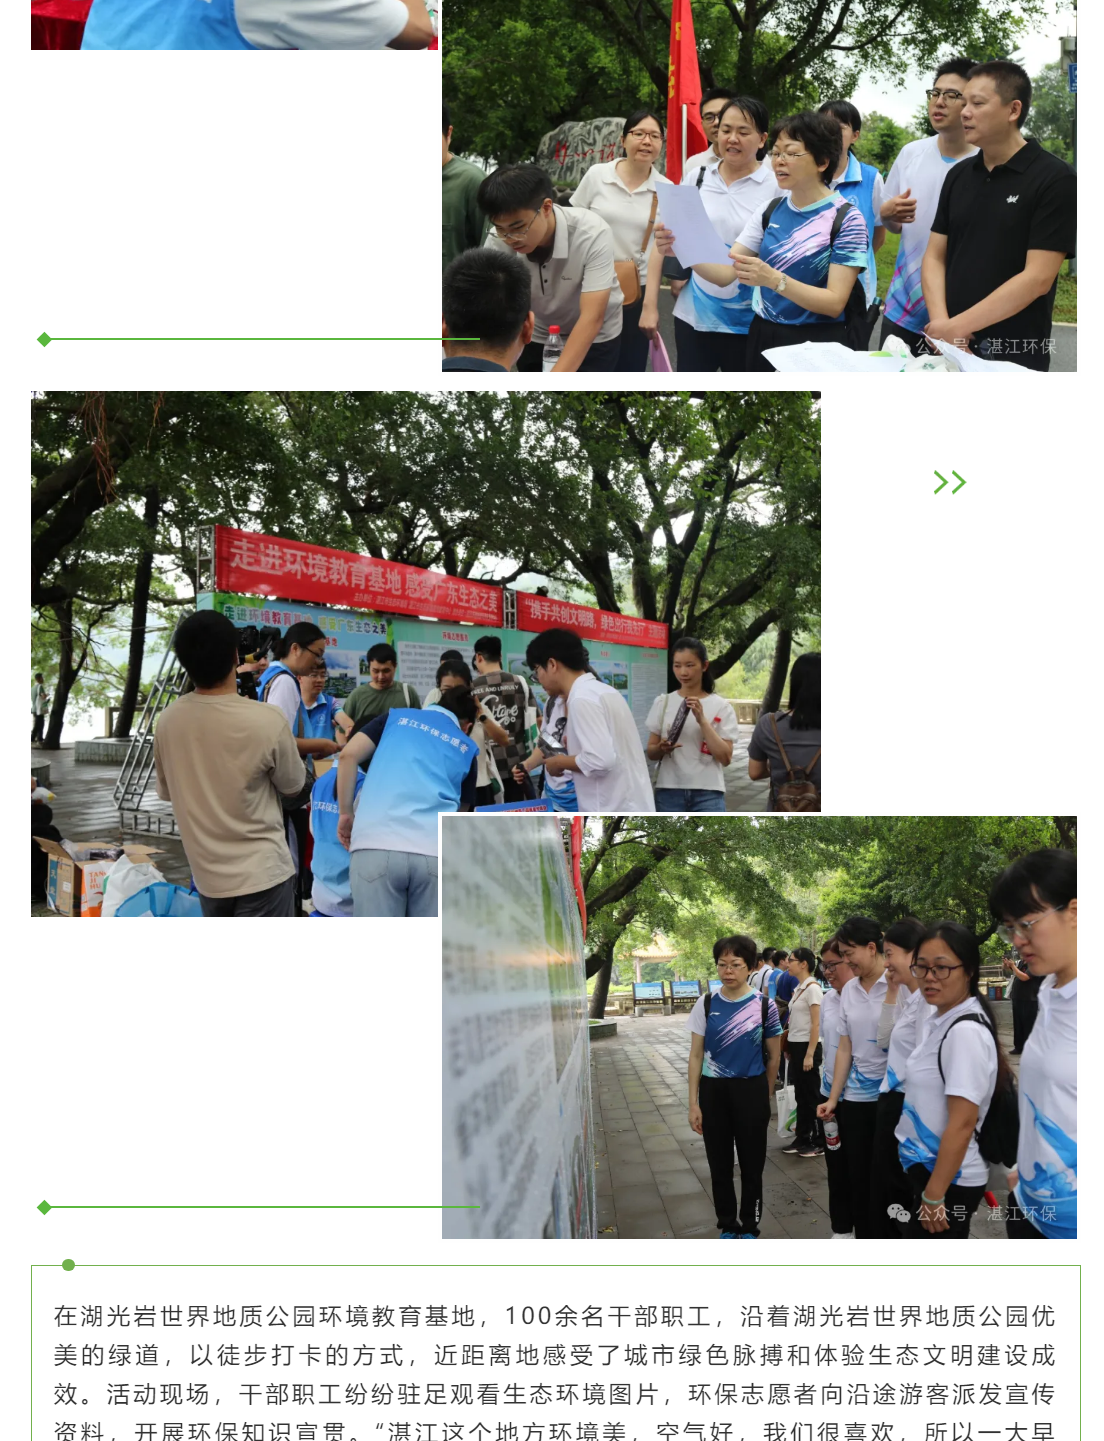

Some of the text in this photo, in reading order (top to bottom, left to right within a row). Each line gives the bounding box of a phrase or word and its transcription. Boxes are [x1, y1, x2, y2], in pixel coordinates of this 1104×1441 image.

[230, 539, 498, 613] 走进环境教育基地 感受广东生态之美
[397, 717, 470, 754] 湛江环保志愿者
